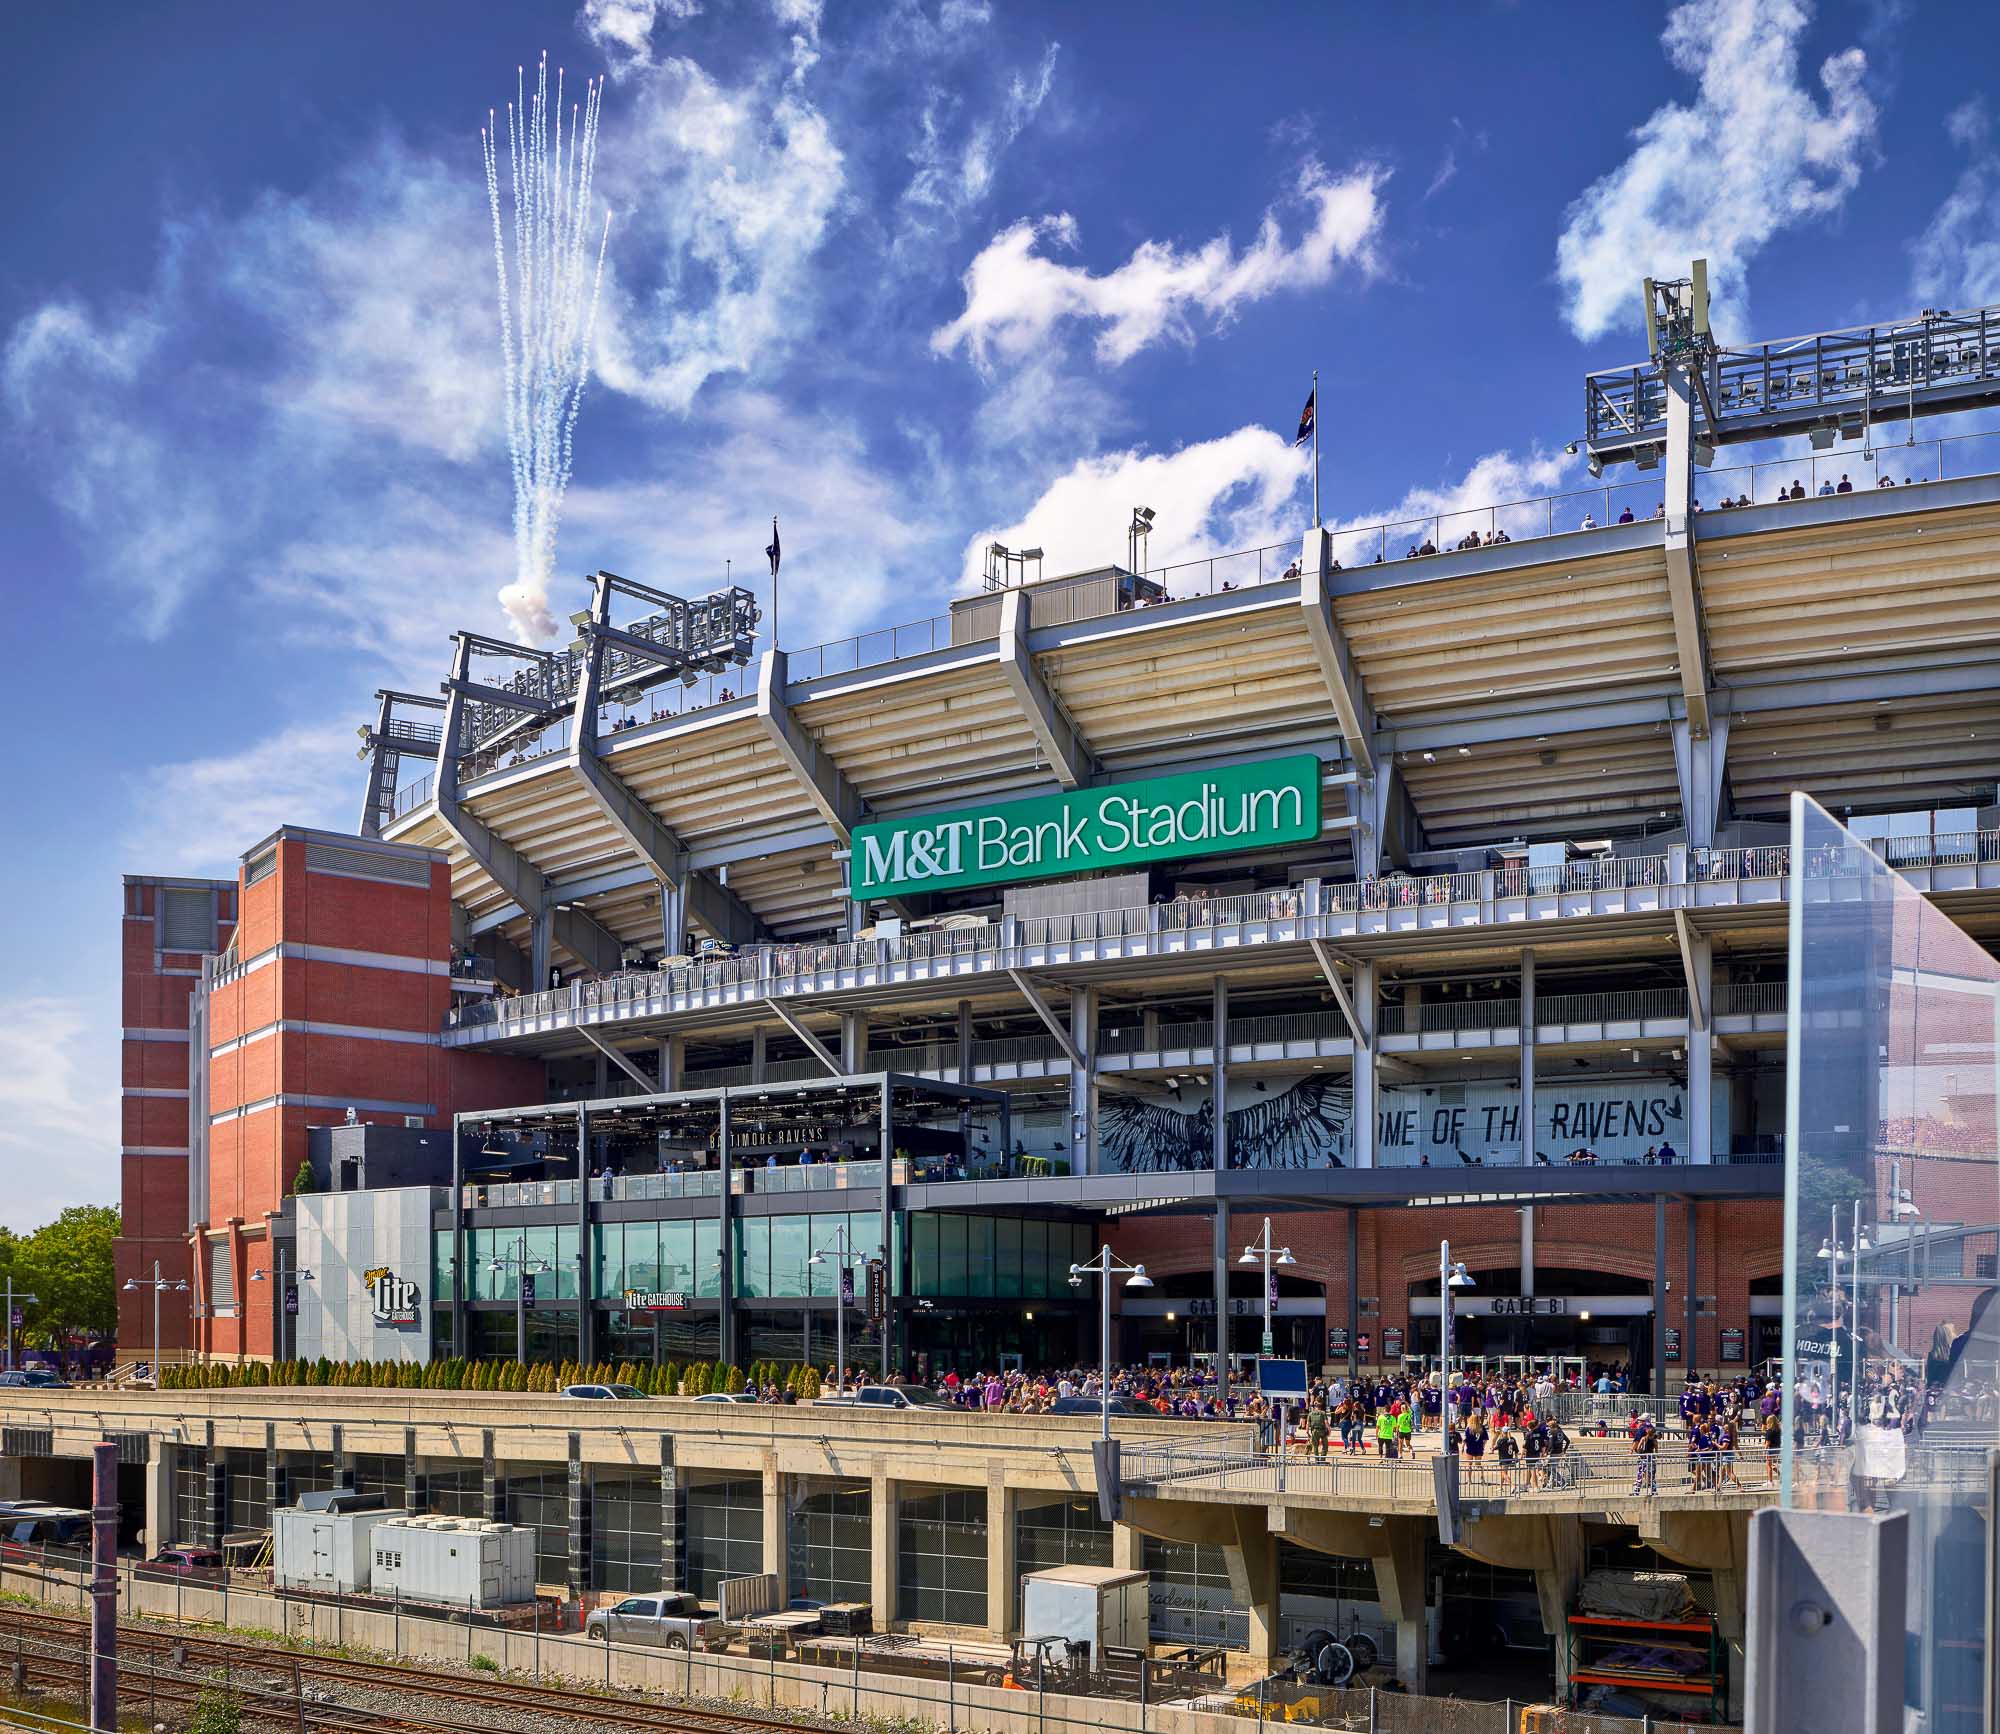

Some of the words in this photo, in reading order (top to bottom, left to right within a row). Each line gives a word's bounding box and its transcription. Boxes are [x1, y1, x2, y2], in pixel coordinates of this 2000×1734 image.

[861, 819, 973, 887] M&T
[977, 805, 1089, 871] Bank
[1096, 783, 1303, 853] Stadium
[1431, 1108, 1467, 1146] OF
[1481, 1105, 1536, 1143] TH
[1550, 1098, 1666, 1140] RAVENS
[372, 1277, 416, 1320] Lite
[628, 1292, 647, 1310] Lite
[647, 1293, 684, 1306] GATEHOUSE
[1191, 1299, 1219, 1314] GAT
[1494, 1298, 1537, 1315] GATE
[1549, 1298, 1558, 1314] B
[1149, 1587, 1208, 1616] cademy
